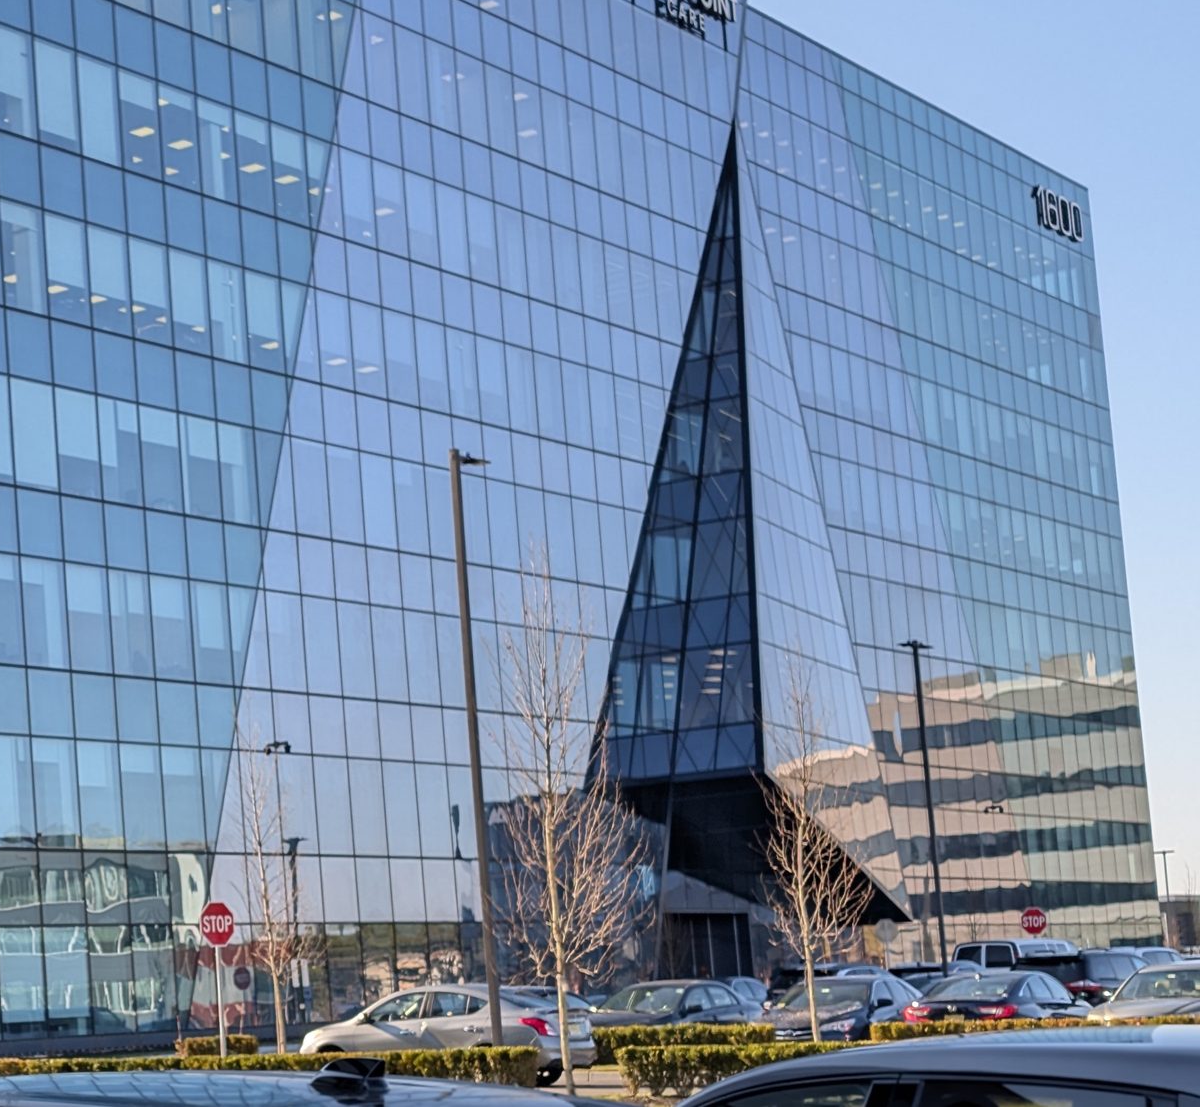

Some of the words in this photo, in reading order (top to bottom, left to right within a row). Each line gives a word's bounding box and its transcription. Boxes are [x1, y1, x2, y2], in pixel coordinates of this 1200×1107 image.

[1037, 185, 1084, 242] 1600
[202, 914, 233, 934] STOP
[1022, 915, 1046, 928] STOP
